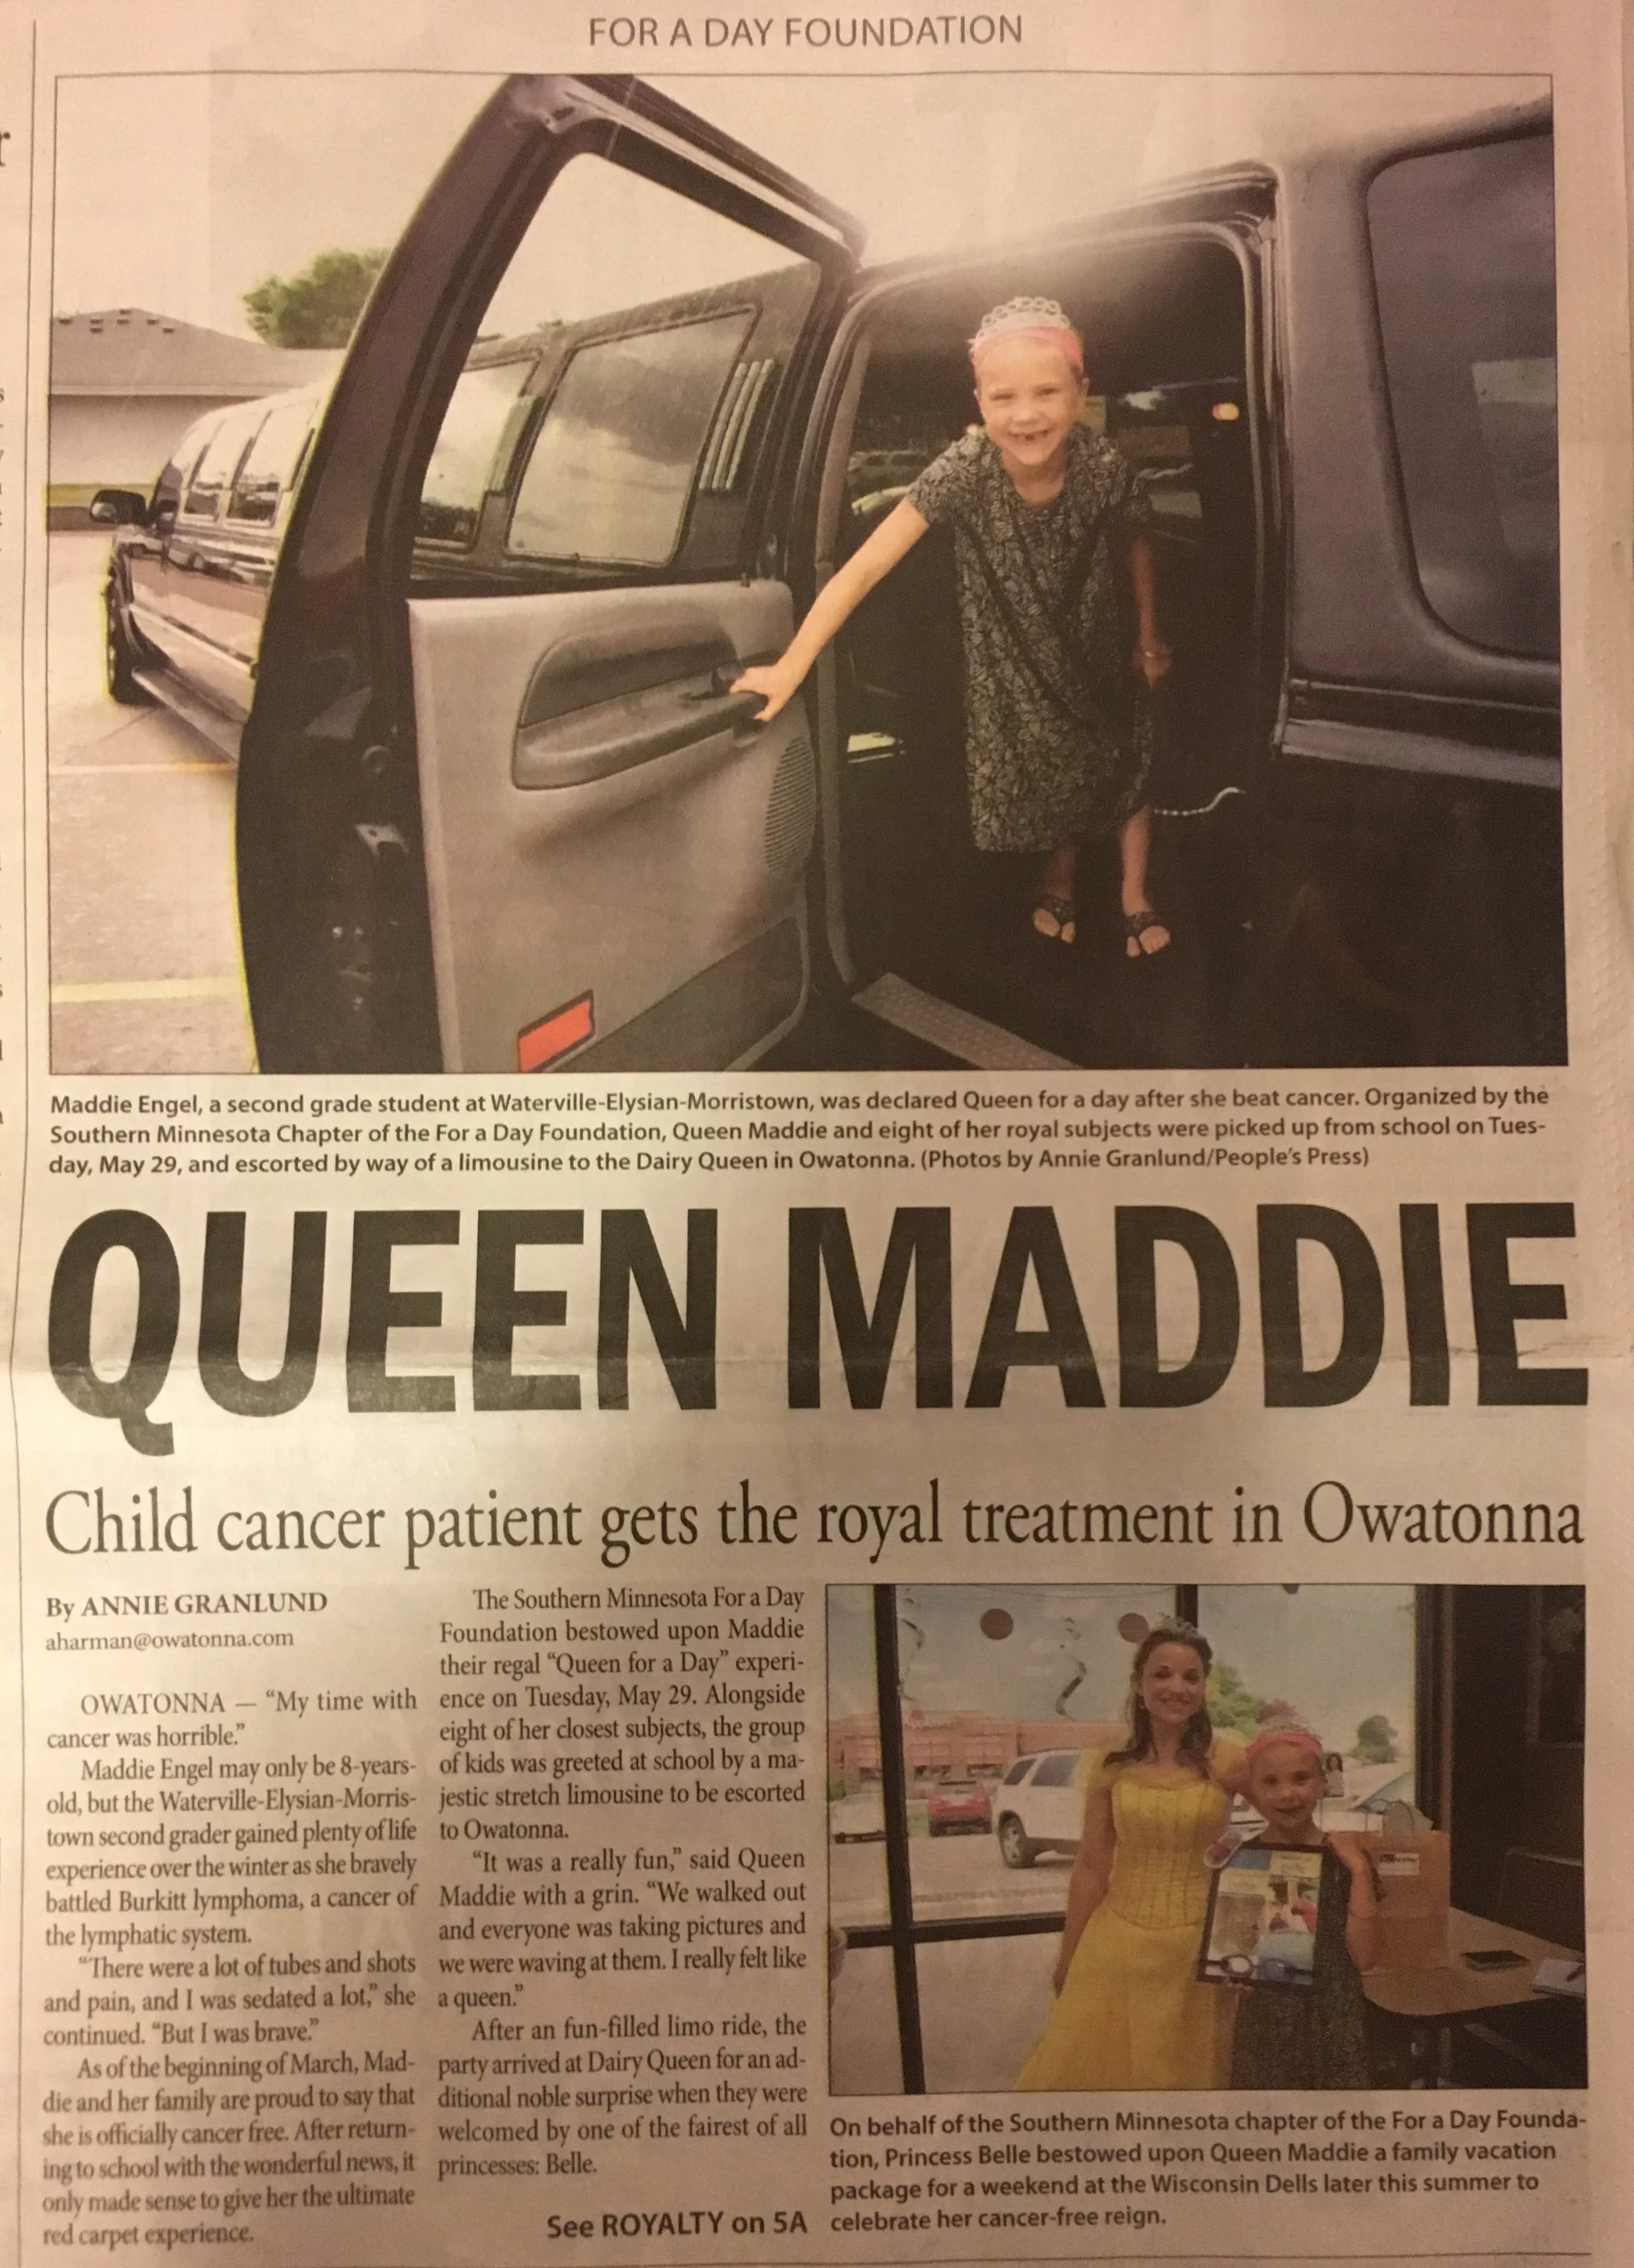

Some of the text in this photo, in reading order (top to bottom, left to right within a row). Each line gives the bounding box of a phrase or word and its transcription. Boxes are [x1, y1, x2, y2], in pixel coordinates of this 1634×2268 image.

[590, 14, 1022, 48] FOR A DAY FOUNDATION
[51, 1086, 1550, 1118] Maddie Engel, a second grade student at Waterville-Elysian-Morristown, was declared Queen for a day after she beat cancer. Organized by the
[48, 1155, 92, 1178] day,
[99, 1156, 145, 1178] May
[151, 1156, 182, 1176] 29,
[188, 1154, 229, 1173] and
[235, 1154, 327, 1173] escorted
[335, 1154, 361, 1176] by
[366, 1158, 408, 1176] way
[414, 1153, 437, 1171] of
[441, 1158, 452, 1171] a
[459, 1153, 563, 1171] limousine
[569, 1154, 590, 1171] to
[596, 1152, 630, 1171] the
[637, 1152, 693, 1175] Dairy
[698, 1152, 767, 1171] Queen
[775, 1151, 793, 1169] in
[799, 1150, 915, 1169] Owatonna.
[921, 1150, 1001, 1171] (Photos
[1008, 1149, 1033, 1172] by
[1039, 1149, 1101, 1167] Annie
[1308, 1146, 1369, 1167] Press)
[48, 1202, 1588, 1456] QUEEN MADDIE
[46, 1478, 1585, 1571] Child cancer patient gets the royal treatment in Owatonna
[46, 1592, 327, 1623] By ANNIE GRANLUND
[473, 1586, 805, 1613] The Southern Minnesota For a Day
[46, 1632, 294, 1651] aharman@owatonna.com
[439, 1616, 804, 1646] Foundation bestowed upon Maddie
[440, 1682, 805, 1713] ence on Tuesday, May 29. Alongside
[81, 1754, 416, 1786] Maddie Engel may only be 8-years-
[46, 1787, 416, 1816] old, but the Waterville-Elysian-Morris-
[438, 1779, 805, 1814] jestic stretch limousine to be escorted
[45, 1922, 252, 1952] the lymphatic system.
[471, 2012, 807, 2041] After an fun-filled limo ride, the
[830, 2109, 1587, 2137] On behalf of the Southern Minnesota chapter of the For a Day Founda-
[438, 2152, 597, 2182] princesses: Belle.
[829, 2141, 1557, 2171] tion, Princess Belle bestowed upon Queen Maddie a family vacation
[831, 2173, 1539, 2205] package for a weekend at the Wisconsin Dells later this summer to
[547, 2210, 808, 2239] See ROYALTY on 5A
[831, 2206, 1166, 2231] celebrate her cancer-free reign.
[43, 2222, 254, 2252] red carpet experience.
